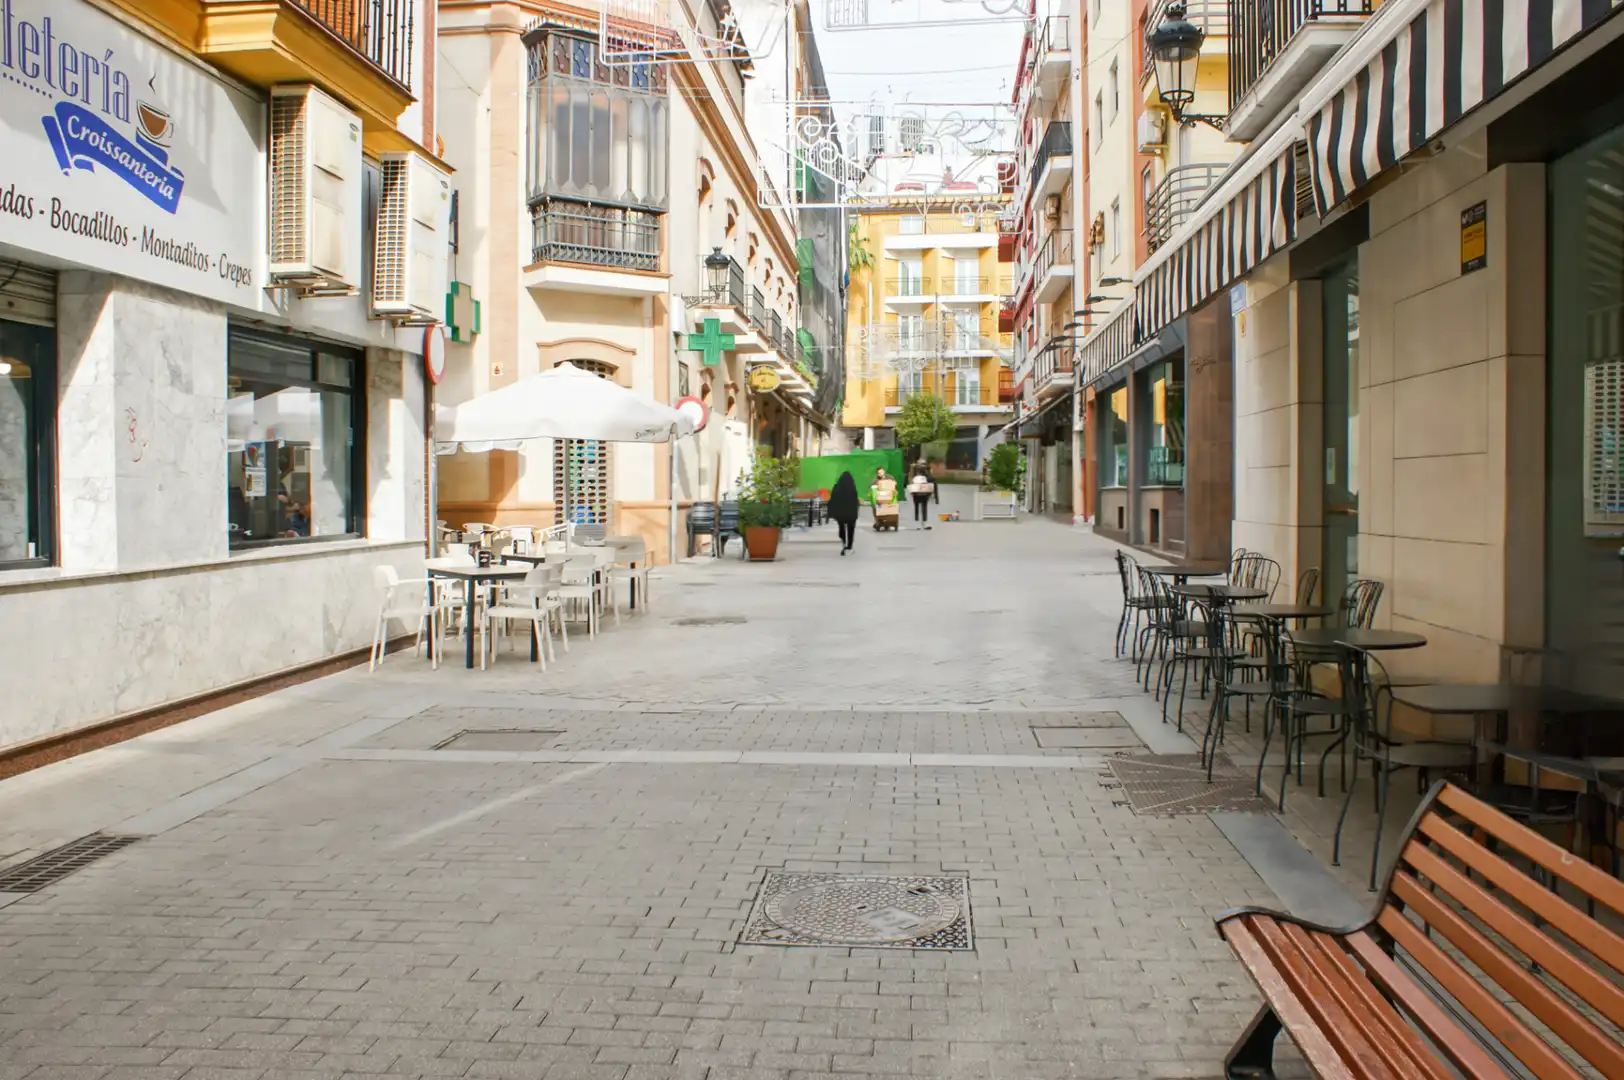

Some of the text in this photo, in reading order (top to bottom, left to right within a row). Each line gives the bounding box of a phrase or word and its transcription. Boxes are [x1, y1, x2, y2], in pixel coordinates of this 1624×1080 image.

[67, 115, 173, 200] Croissanteria
[0, 184, 252, 287] das Bocadillos Montaditos Crepes
